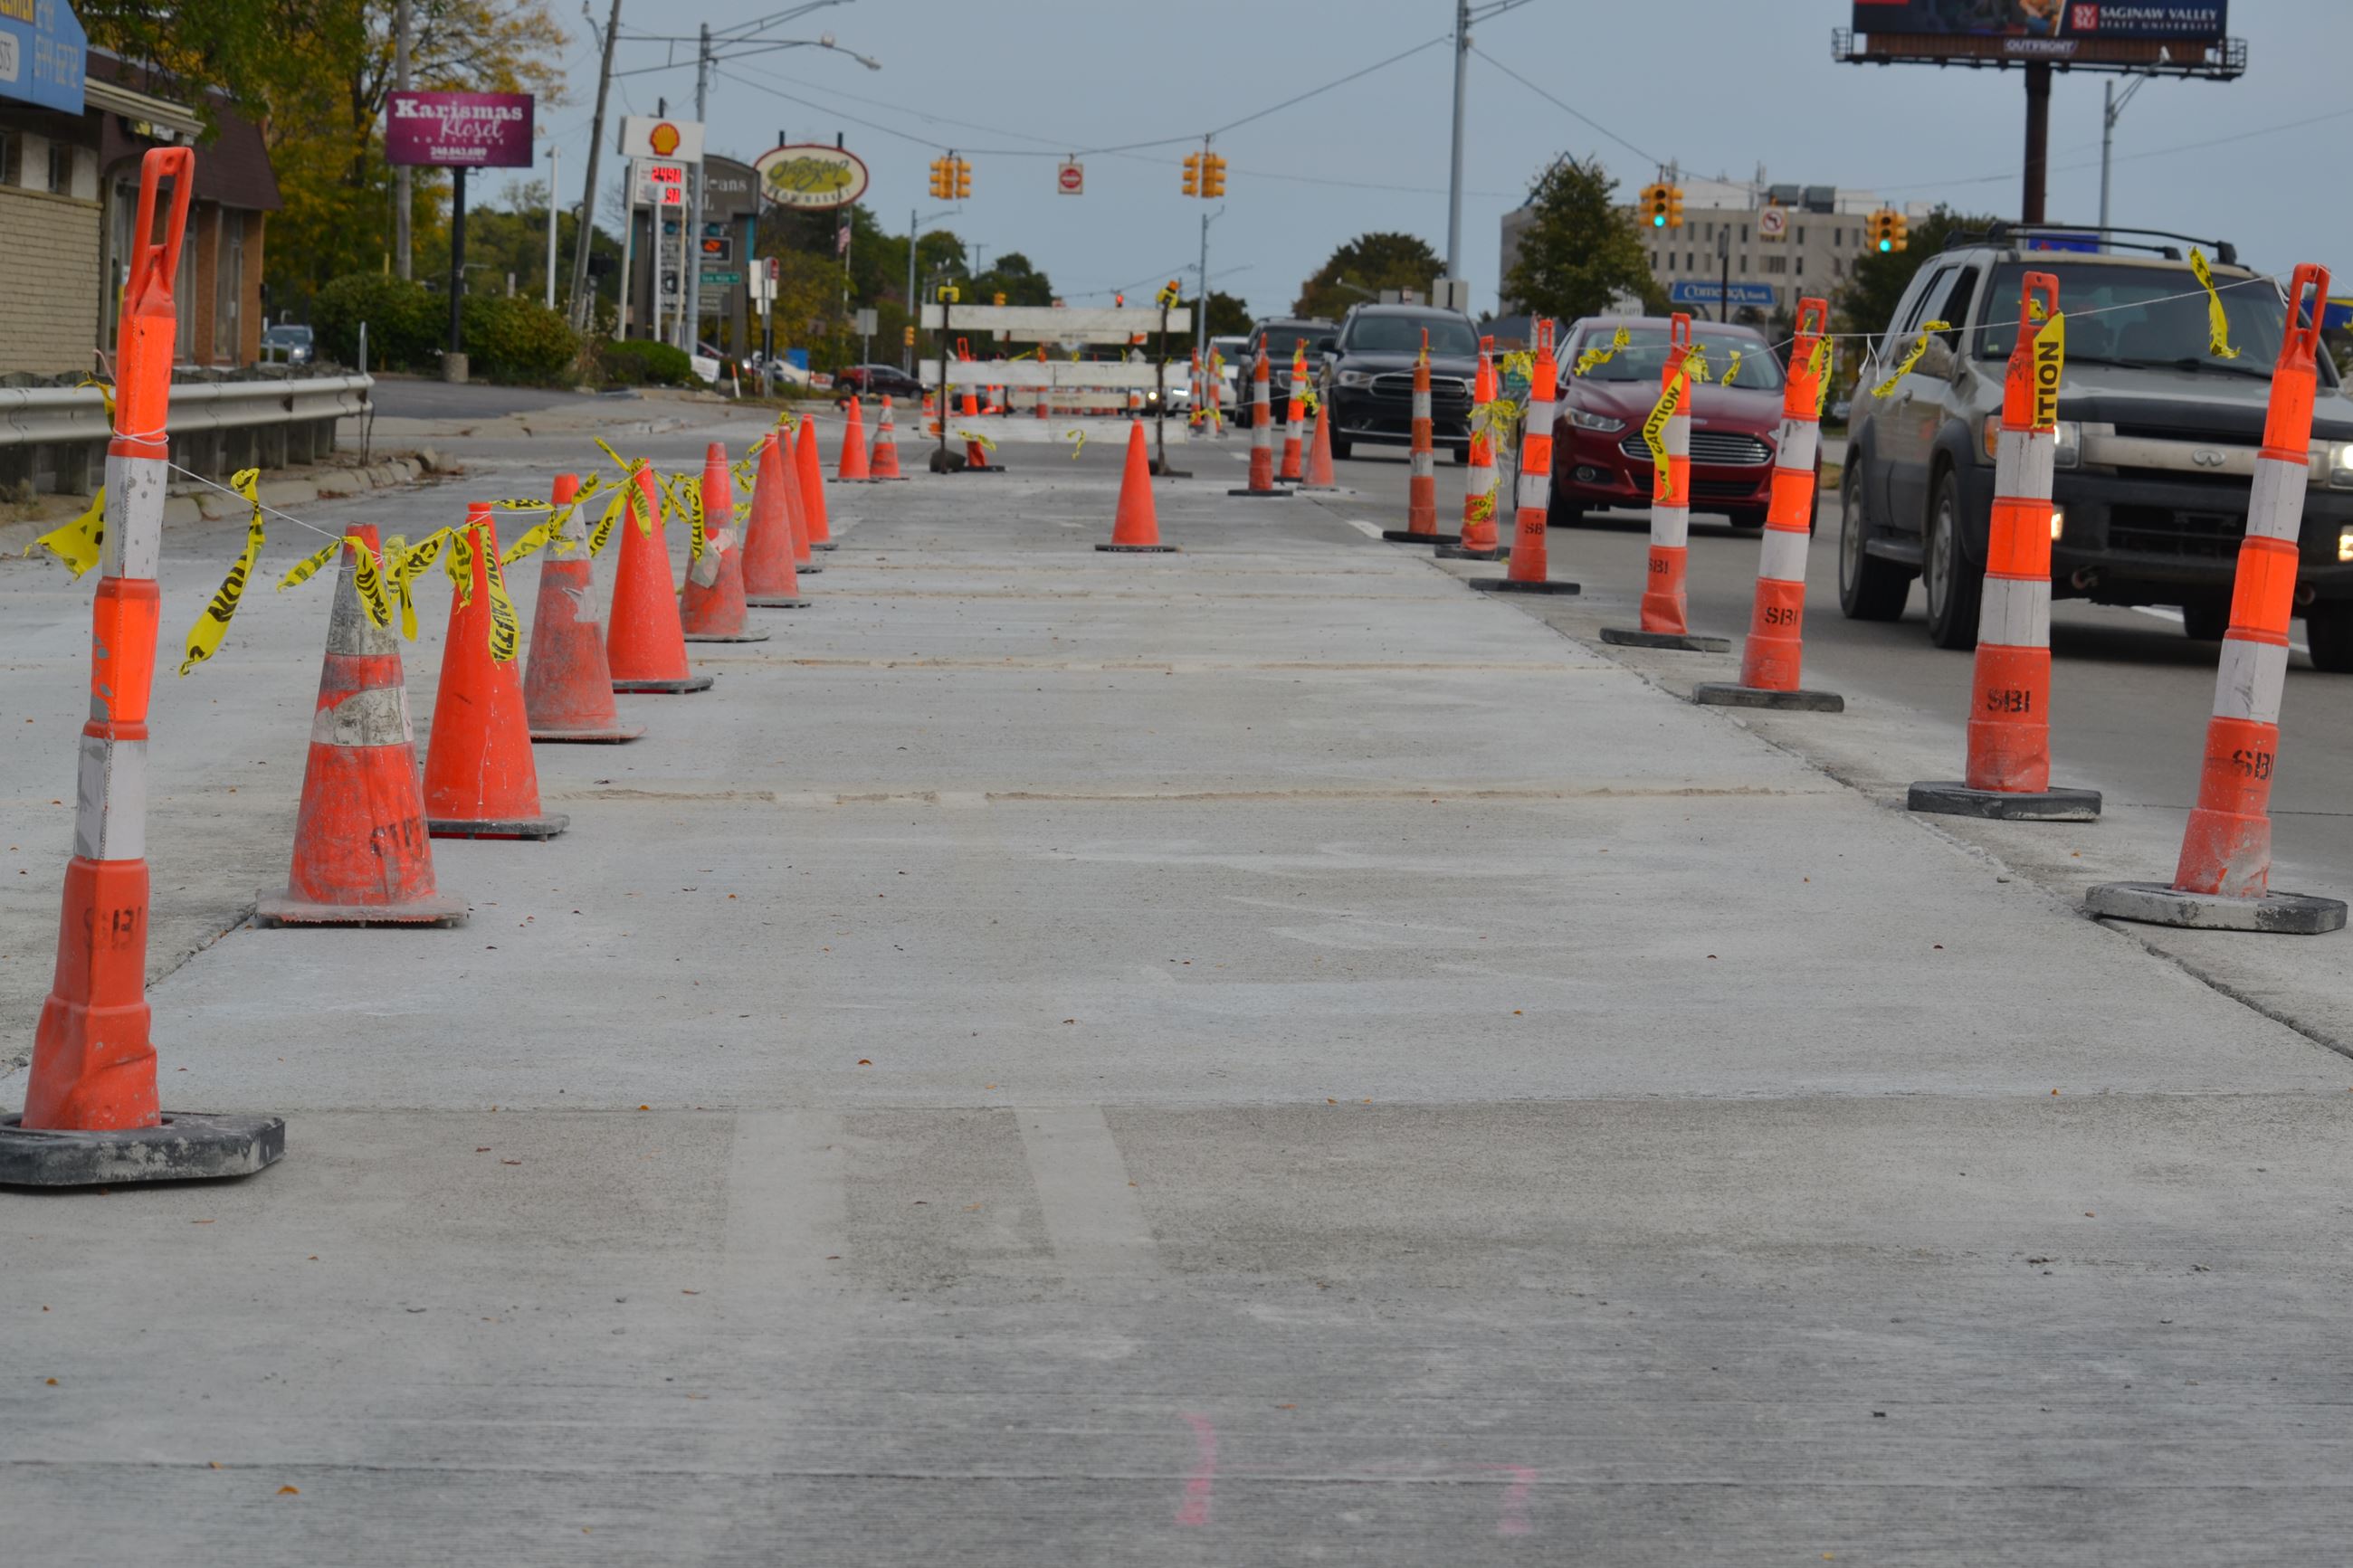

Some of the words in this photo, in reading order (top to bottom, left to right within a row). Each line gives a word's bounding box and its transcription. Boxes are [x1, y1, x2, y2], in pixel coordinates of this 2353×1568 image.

[2100, 7, 2165, 20] SAGINAW
[2168, 8, 2217, 21] VALLEY
[2100, 20, 2134, 29] STATE
[2141, 21, 2217, 31] UNIVERSITY
[2005, 40, 2075, 52] OUTFRONT
[395, 99, 523, 120] Karismas
[1644, 385, 1681, 455] CAUTION
[1765, 606, 1797, 626] SBI
[1986, 689, 2031, 713] SBI
